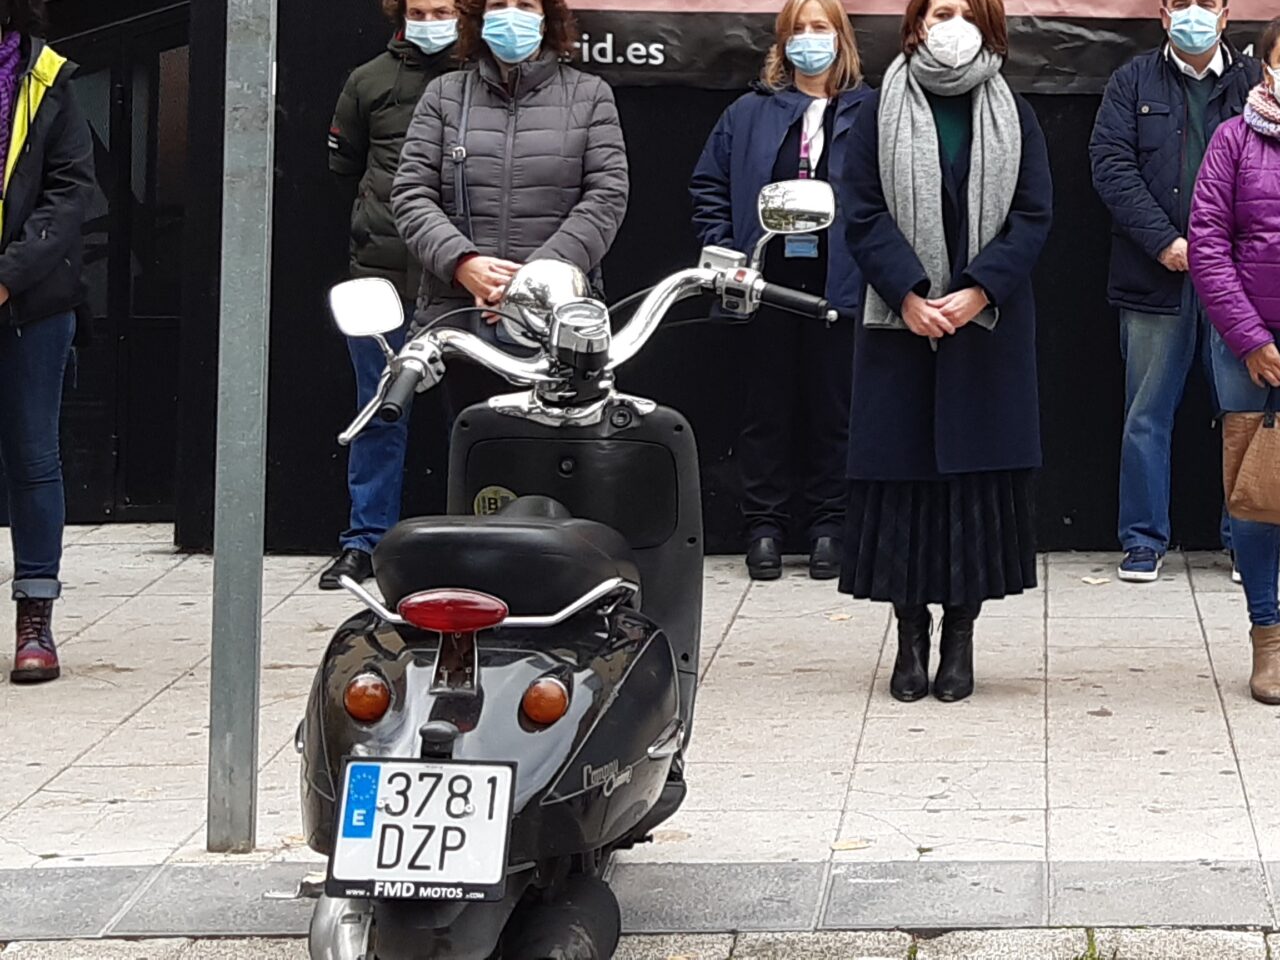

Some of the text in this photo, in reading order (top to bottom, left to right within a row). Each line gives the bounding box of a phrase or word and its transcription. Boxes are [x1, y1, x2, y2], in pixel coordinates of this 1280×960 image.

[384, 772, 498, 820] 3781
[352, 809, 366, 826] E
[376, 823, 466, 871] DZP
[374, 881, 415, 898] FMD
[419, 886, 463, 898] MOTOS
